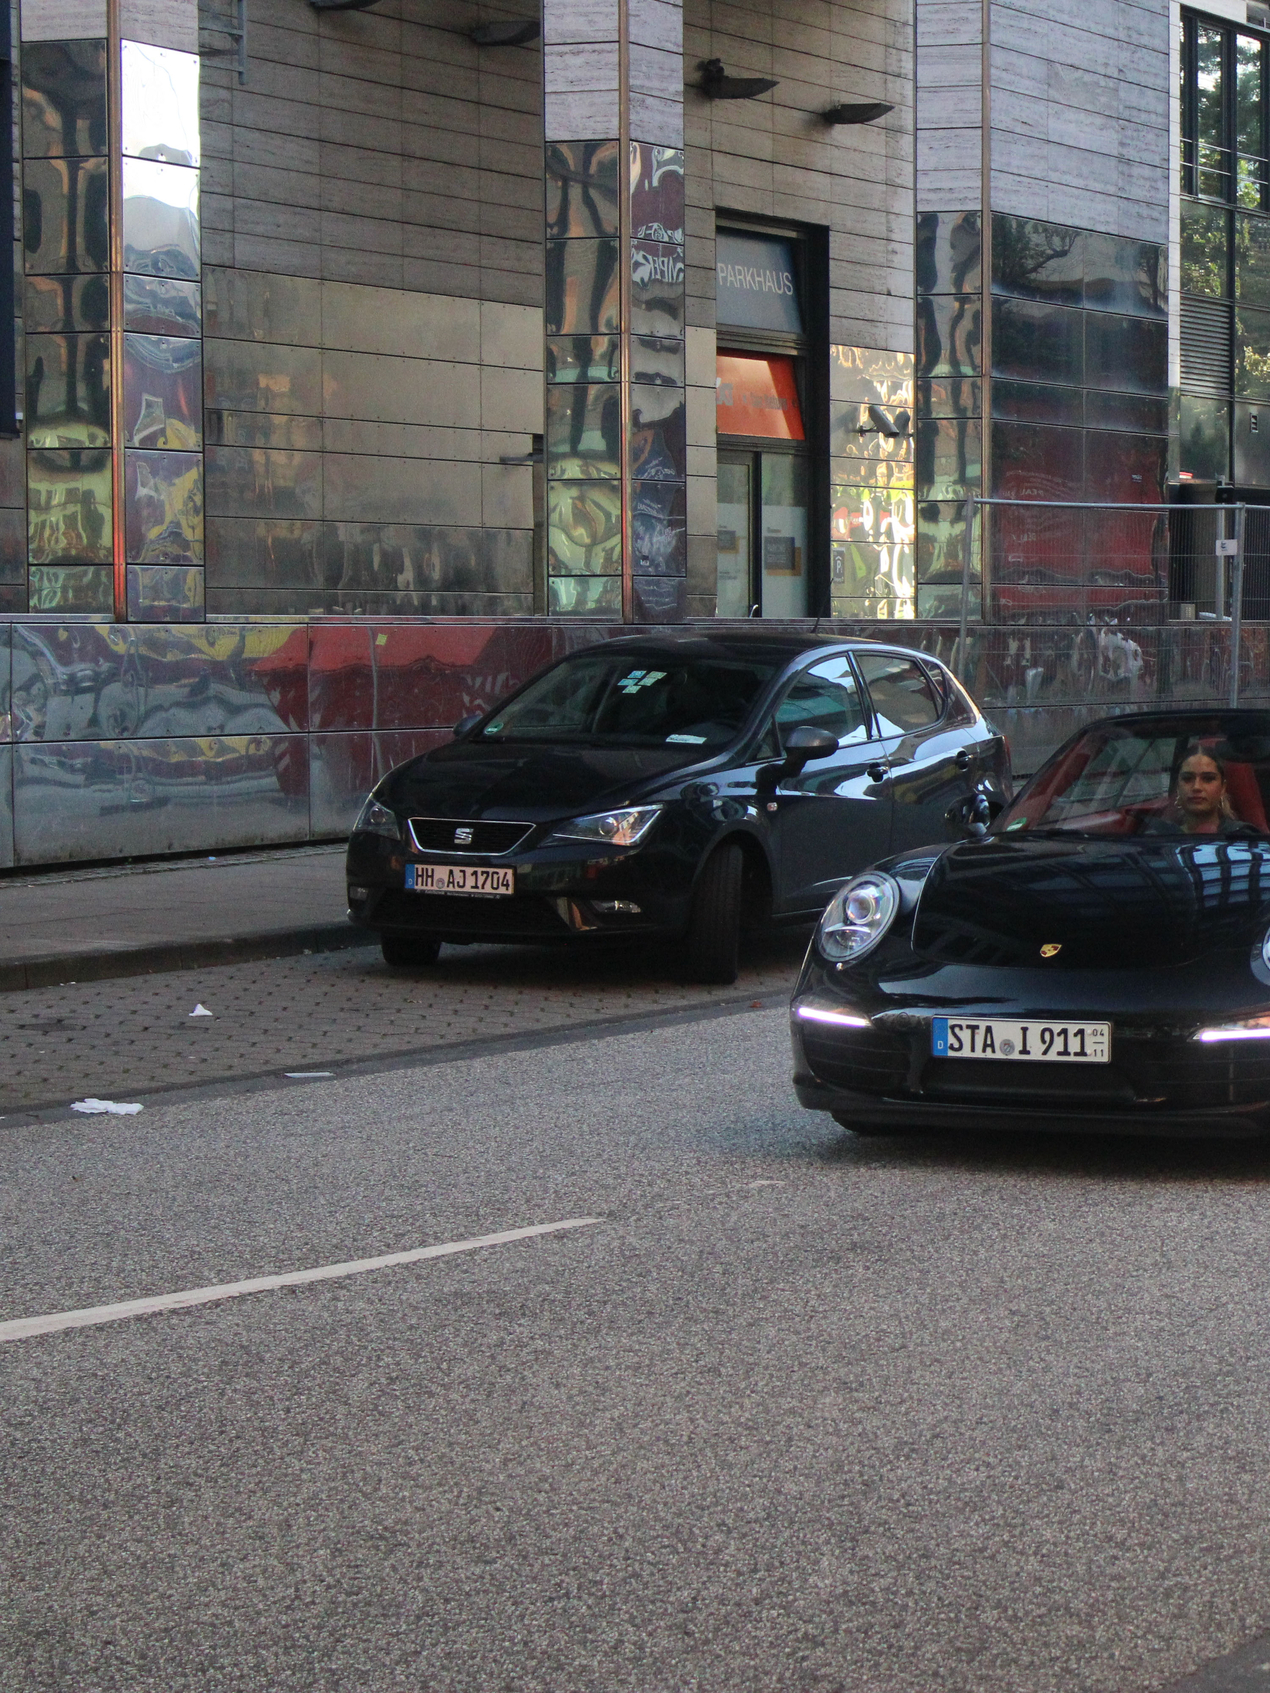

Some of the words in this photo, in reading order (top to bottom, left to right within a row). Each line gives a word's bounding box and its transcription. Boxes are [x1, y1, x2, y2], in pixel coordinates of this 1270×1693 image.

[717, 262, 794, 296] PARKHAUS
[415, 867, 434, 888] HH
[446, 868, 466, 890] AJ
[470, 870, 511, 891] 1704
[948, 1023, 996, 1054] STA
[1018, 1026, 1031, 1056] I
[1039, 1027, 1088, 1057] 911
[1092, 1029, 1105, 1037] 04
[1093, 1048, 1105, 1058] 11
